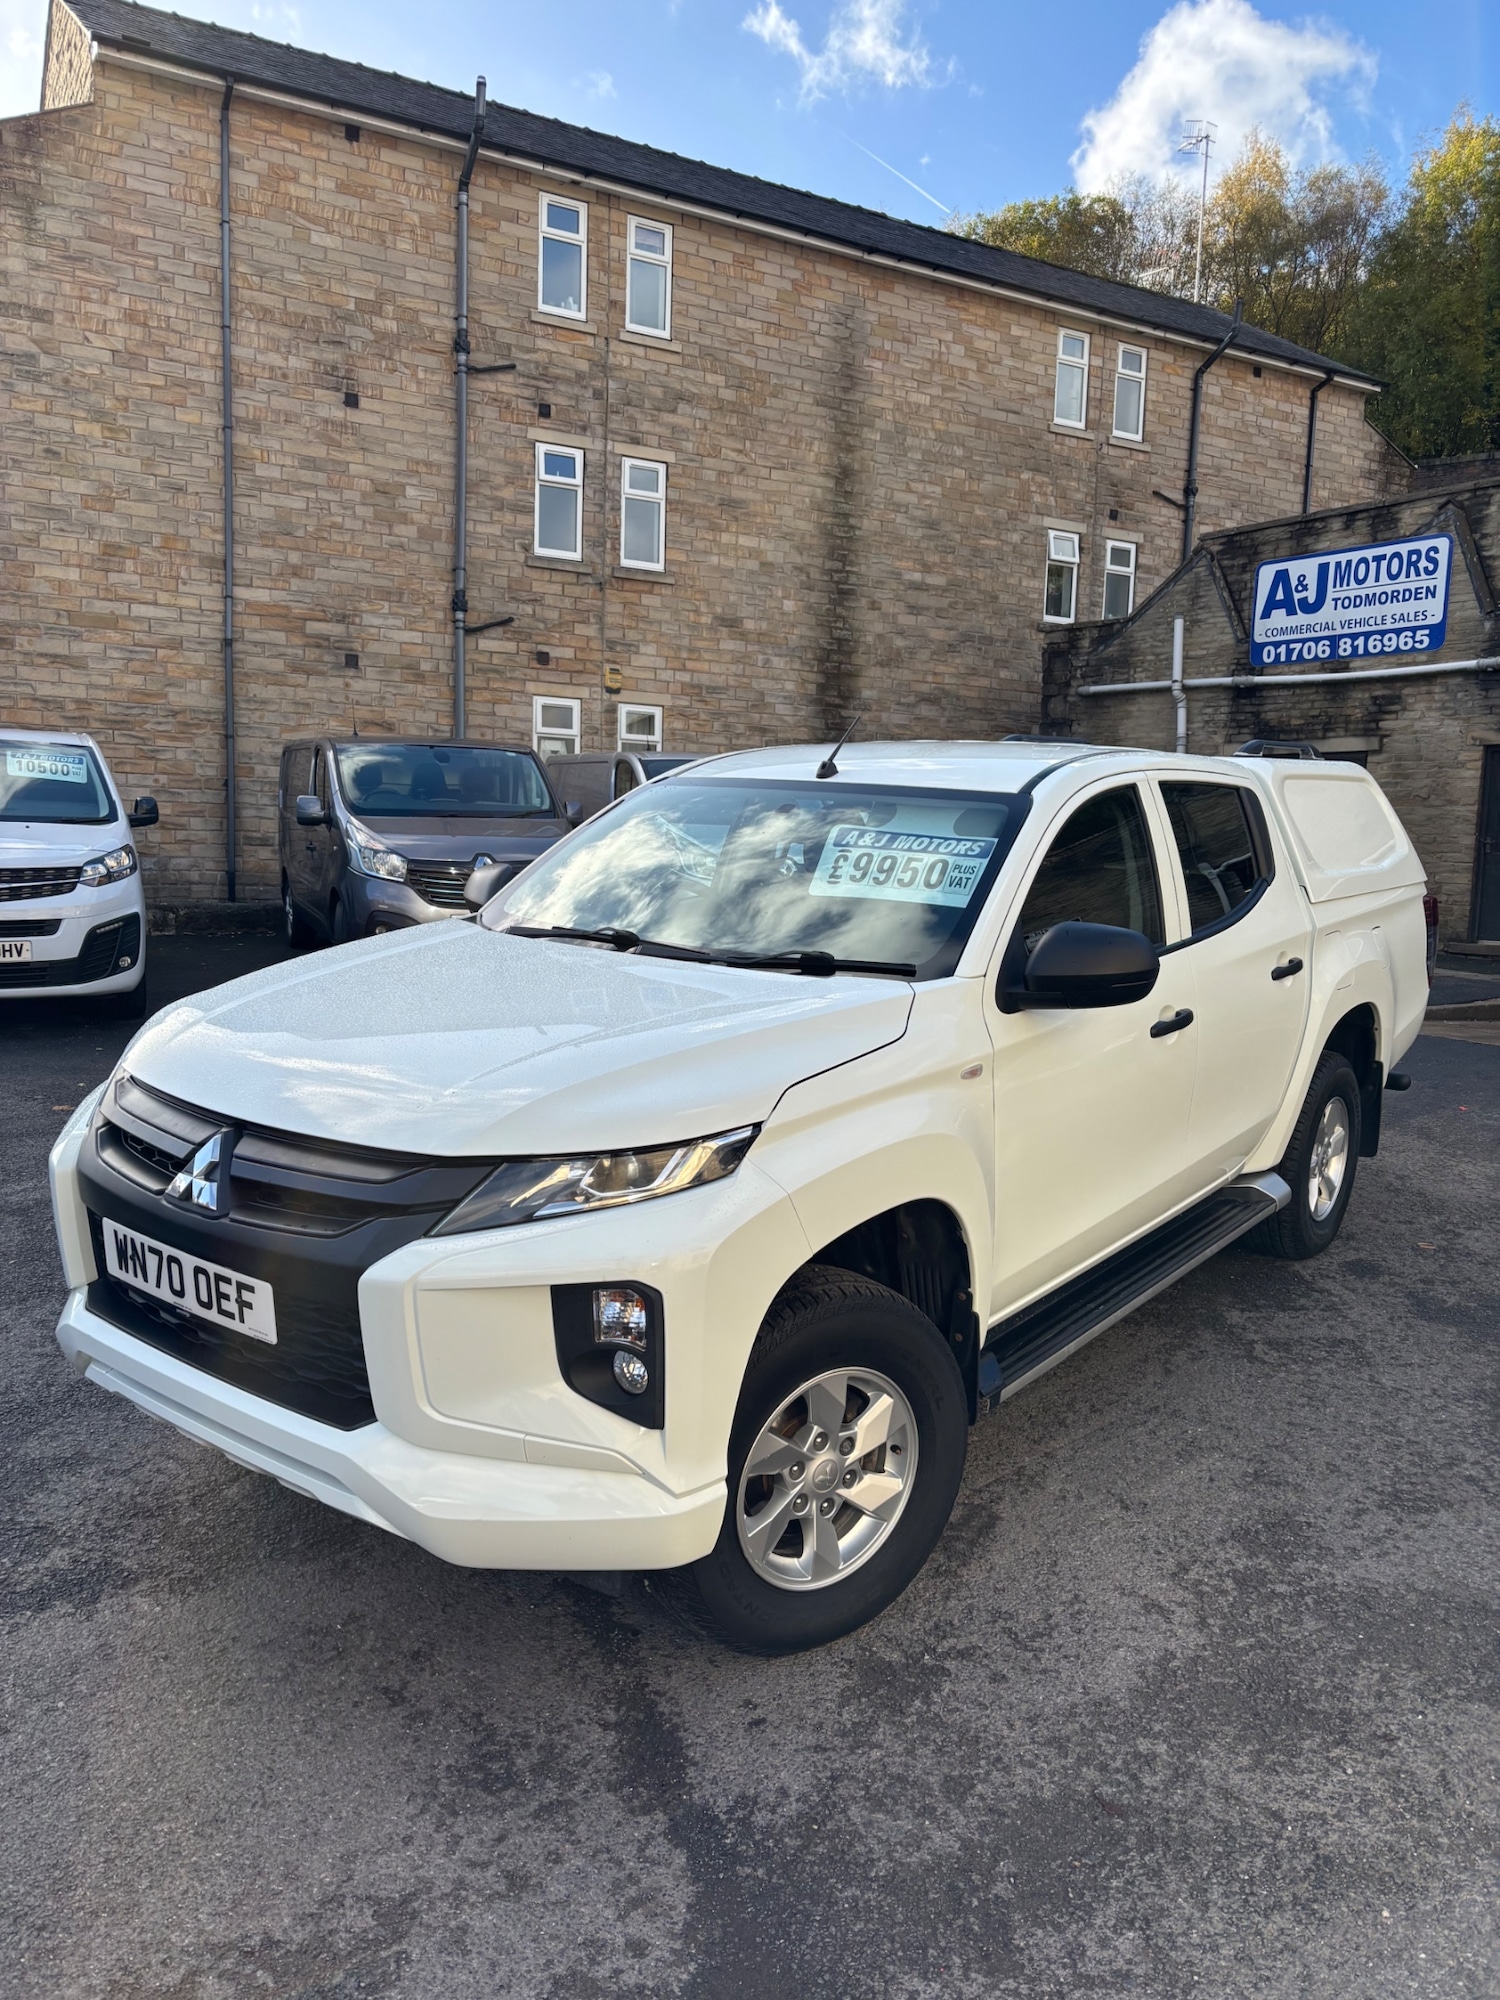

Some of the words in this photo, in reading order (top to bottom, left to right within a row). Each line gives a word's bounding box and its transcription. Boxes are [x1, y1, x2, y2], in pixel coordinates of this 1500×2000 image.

[1332, 545, 1440, 589] MOTORS
[1331, 584, 1437, 611] TODMORDEN
[1264, 620, 1337, 638] COMMERCIAL
[1339, 614, 1388, 630] VEHICLE
[1390, 609, 1428, 625] SALES
[1262, 639, 1331, 664] 01706
[1337, 629, 1430, 656] 816965
[16, 760, 70, 776] 10500
[40, 754, 80, 764] MOTORS
[891, 836, 986, 855] MOTORS
[827, 849, 950, 890] £9950
[952, 863, 977, 875] PLUS
[949, 875, 972, 889] VAT
[0, 943, 24, 958] HV
[113, 1228, 186, 1299] WN70
[193, 1265, 256, 1324] OEF
